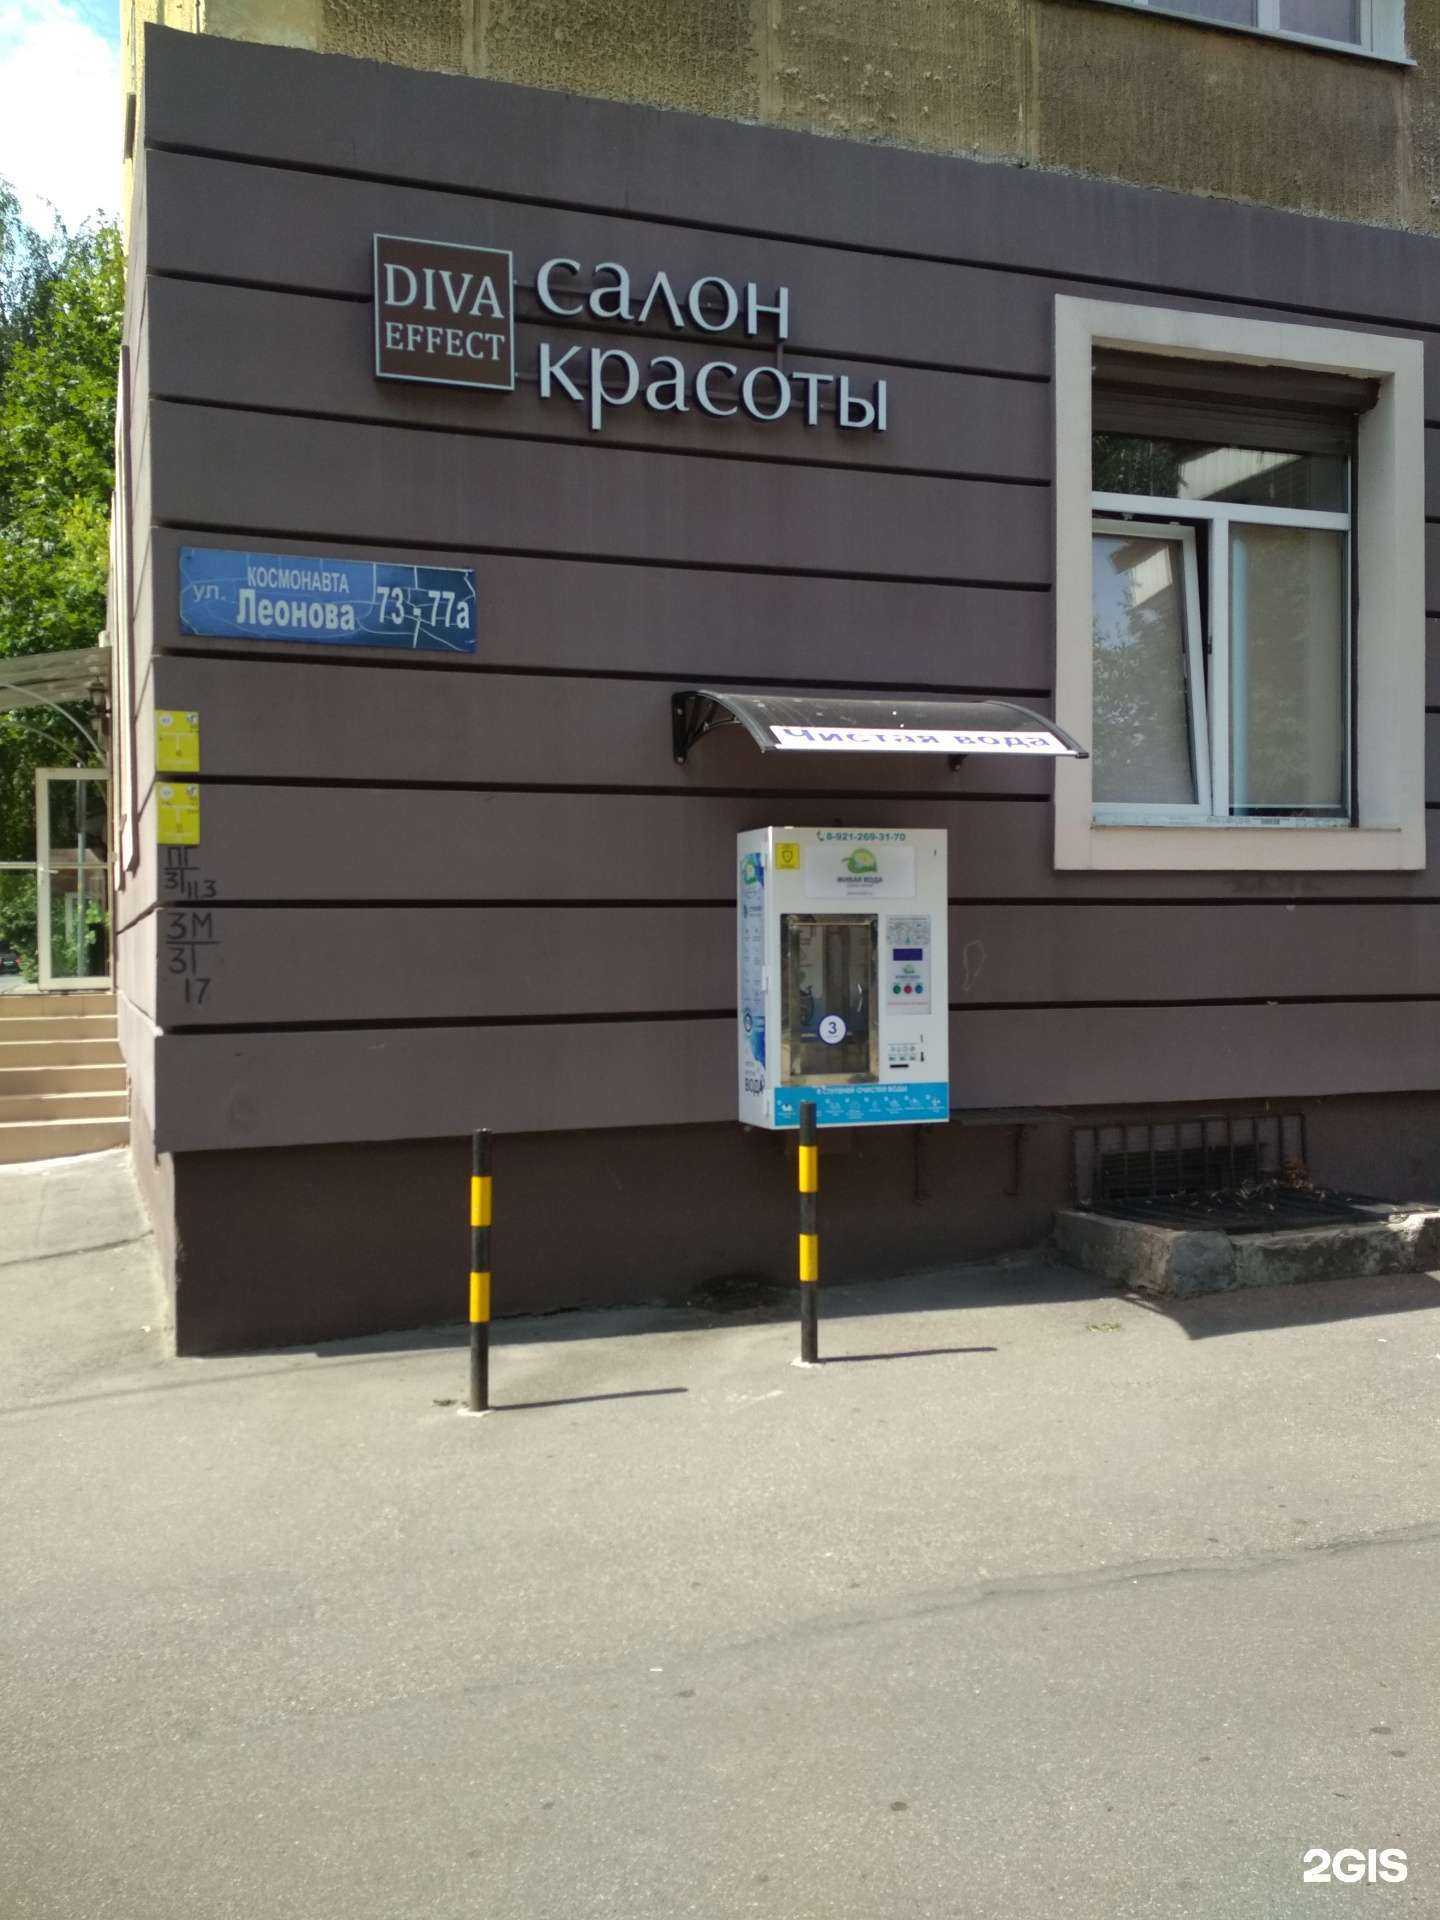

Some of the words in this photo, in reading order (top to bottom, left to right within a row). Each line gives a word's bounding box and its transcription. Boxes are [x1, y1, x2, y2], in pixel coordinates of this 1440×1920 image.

[384, 263, 504, 318] DIVA
[536, 257, 789, 339] салон
[385, 322, 505, 361] EFFECT
[538, 342, 888, 430] красоты
[191, 582, 226, 602] ул.
[247, 566, 350, 593] КОСМОНАВТА
[236, 588, 355, 630] Леонова
[783, 726, 939, 745] Чистая
[954, 733, 1051, 748] вода
[185, 978, 211, 1005] 17
[828, 1021, 837, 1034] 3
